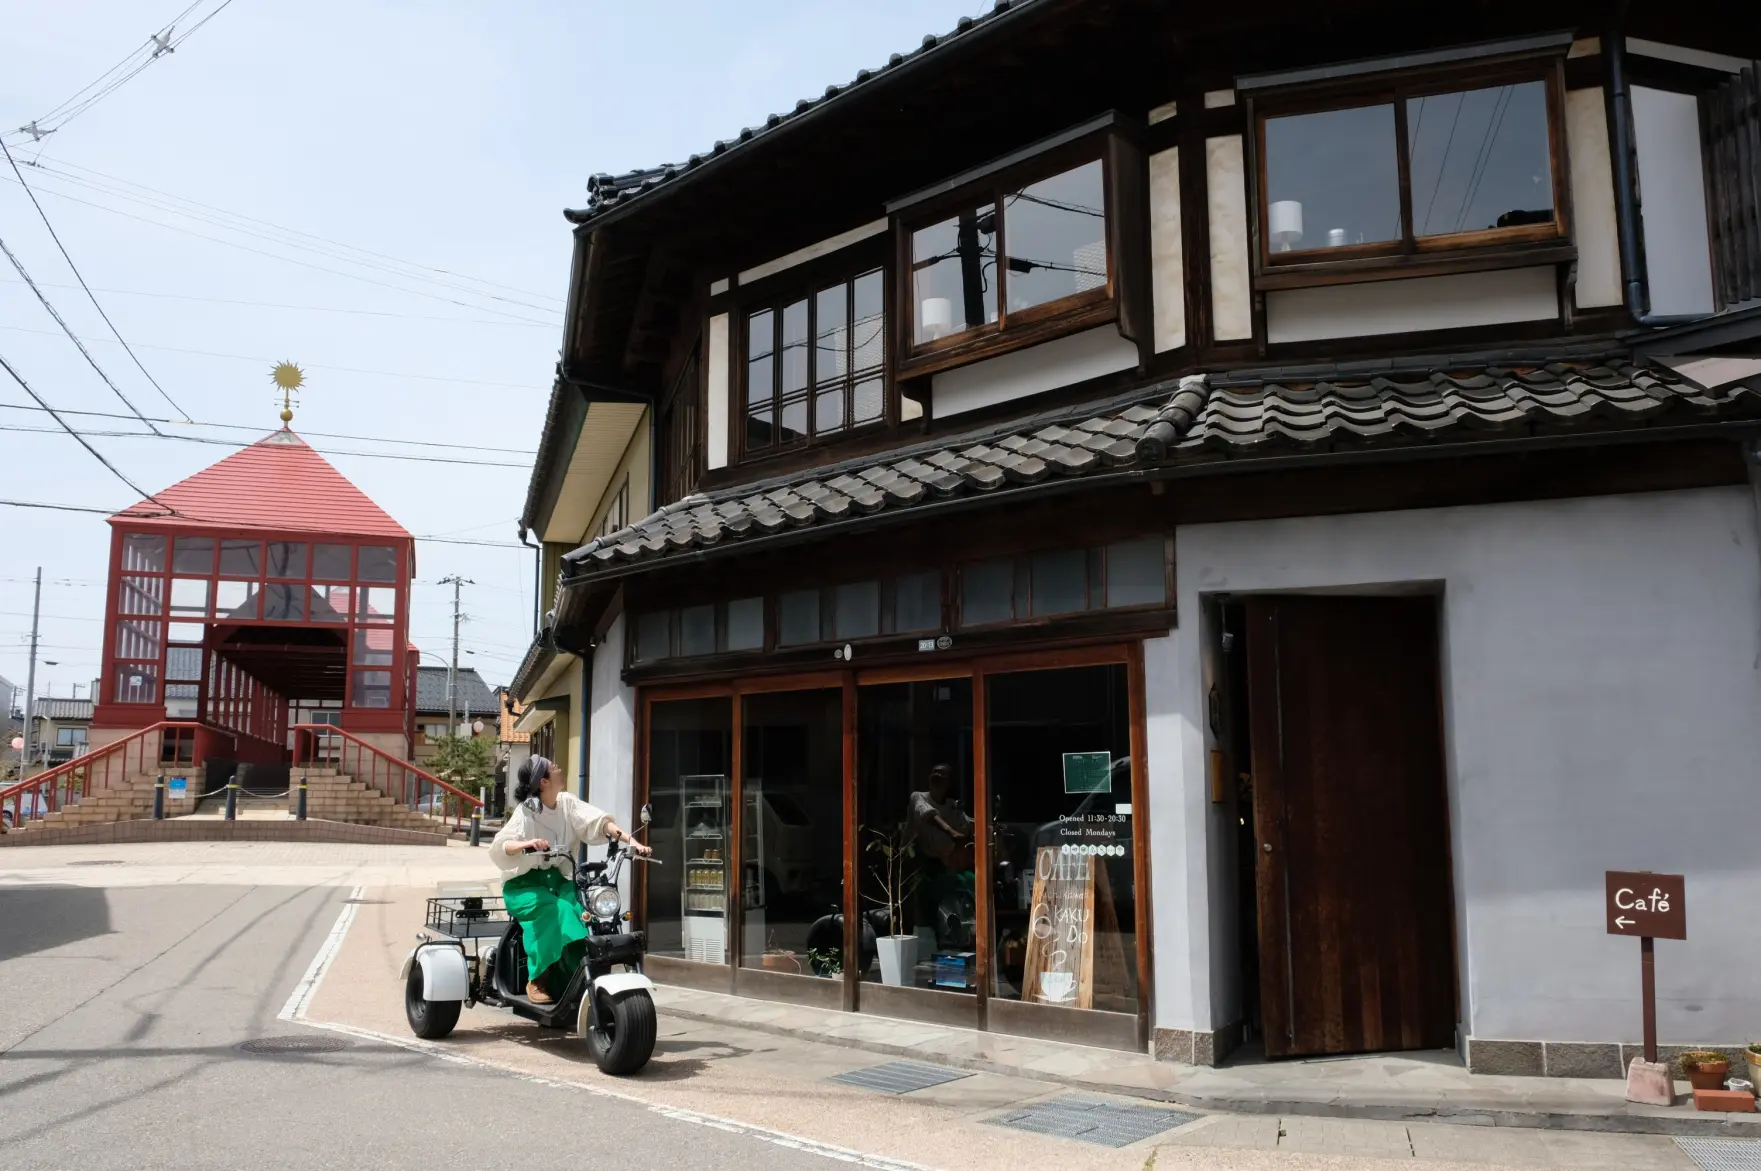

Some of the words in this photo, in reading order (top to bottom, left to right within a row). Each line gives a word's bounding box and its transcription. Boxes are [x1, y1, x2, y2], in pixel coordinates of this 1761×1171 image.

[1059, 814, 1085, 824] Opened
[1060, 828, 1082, 836] Closed
[1086, 828, 1116, 838] Mondays
[1615, 888, 1670, 912] Café
